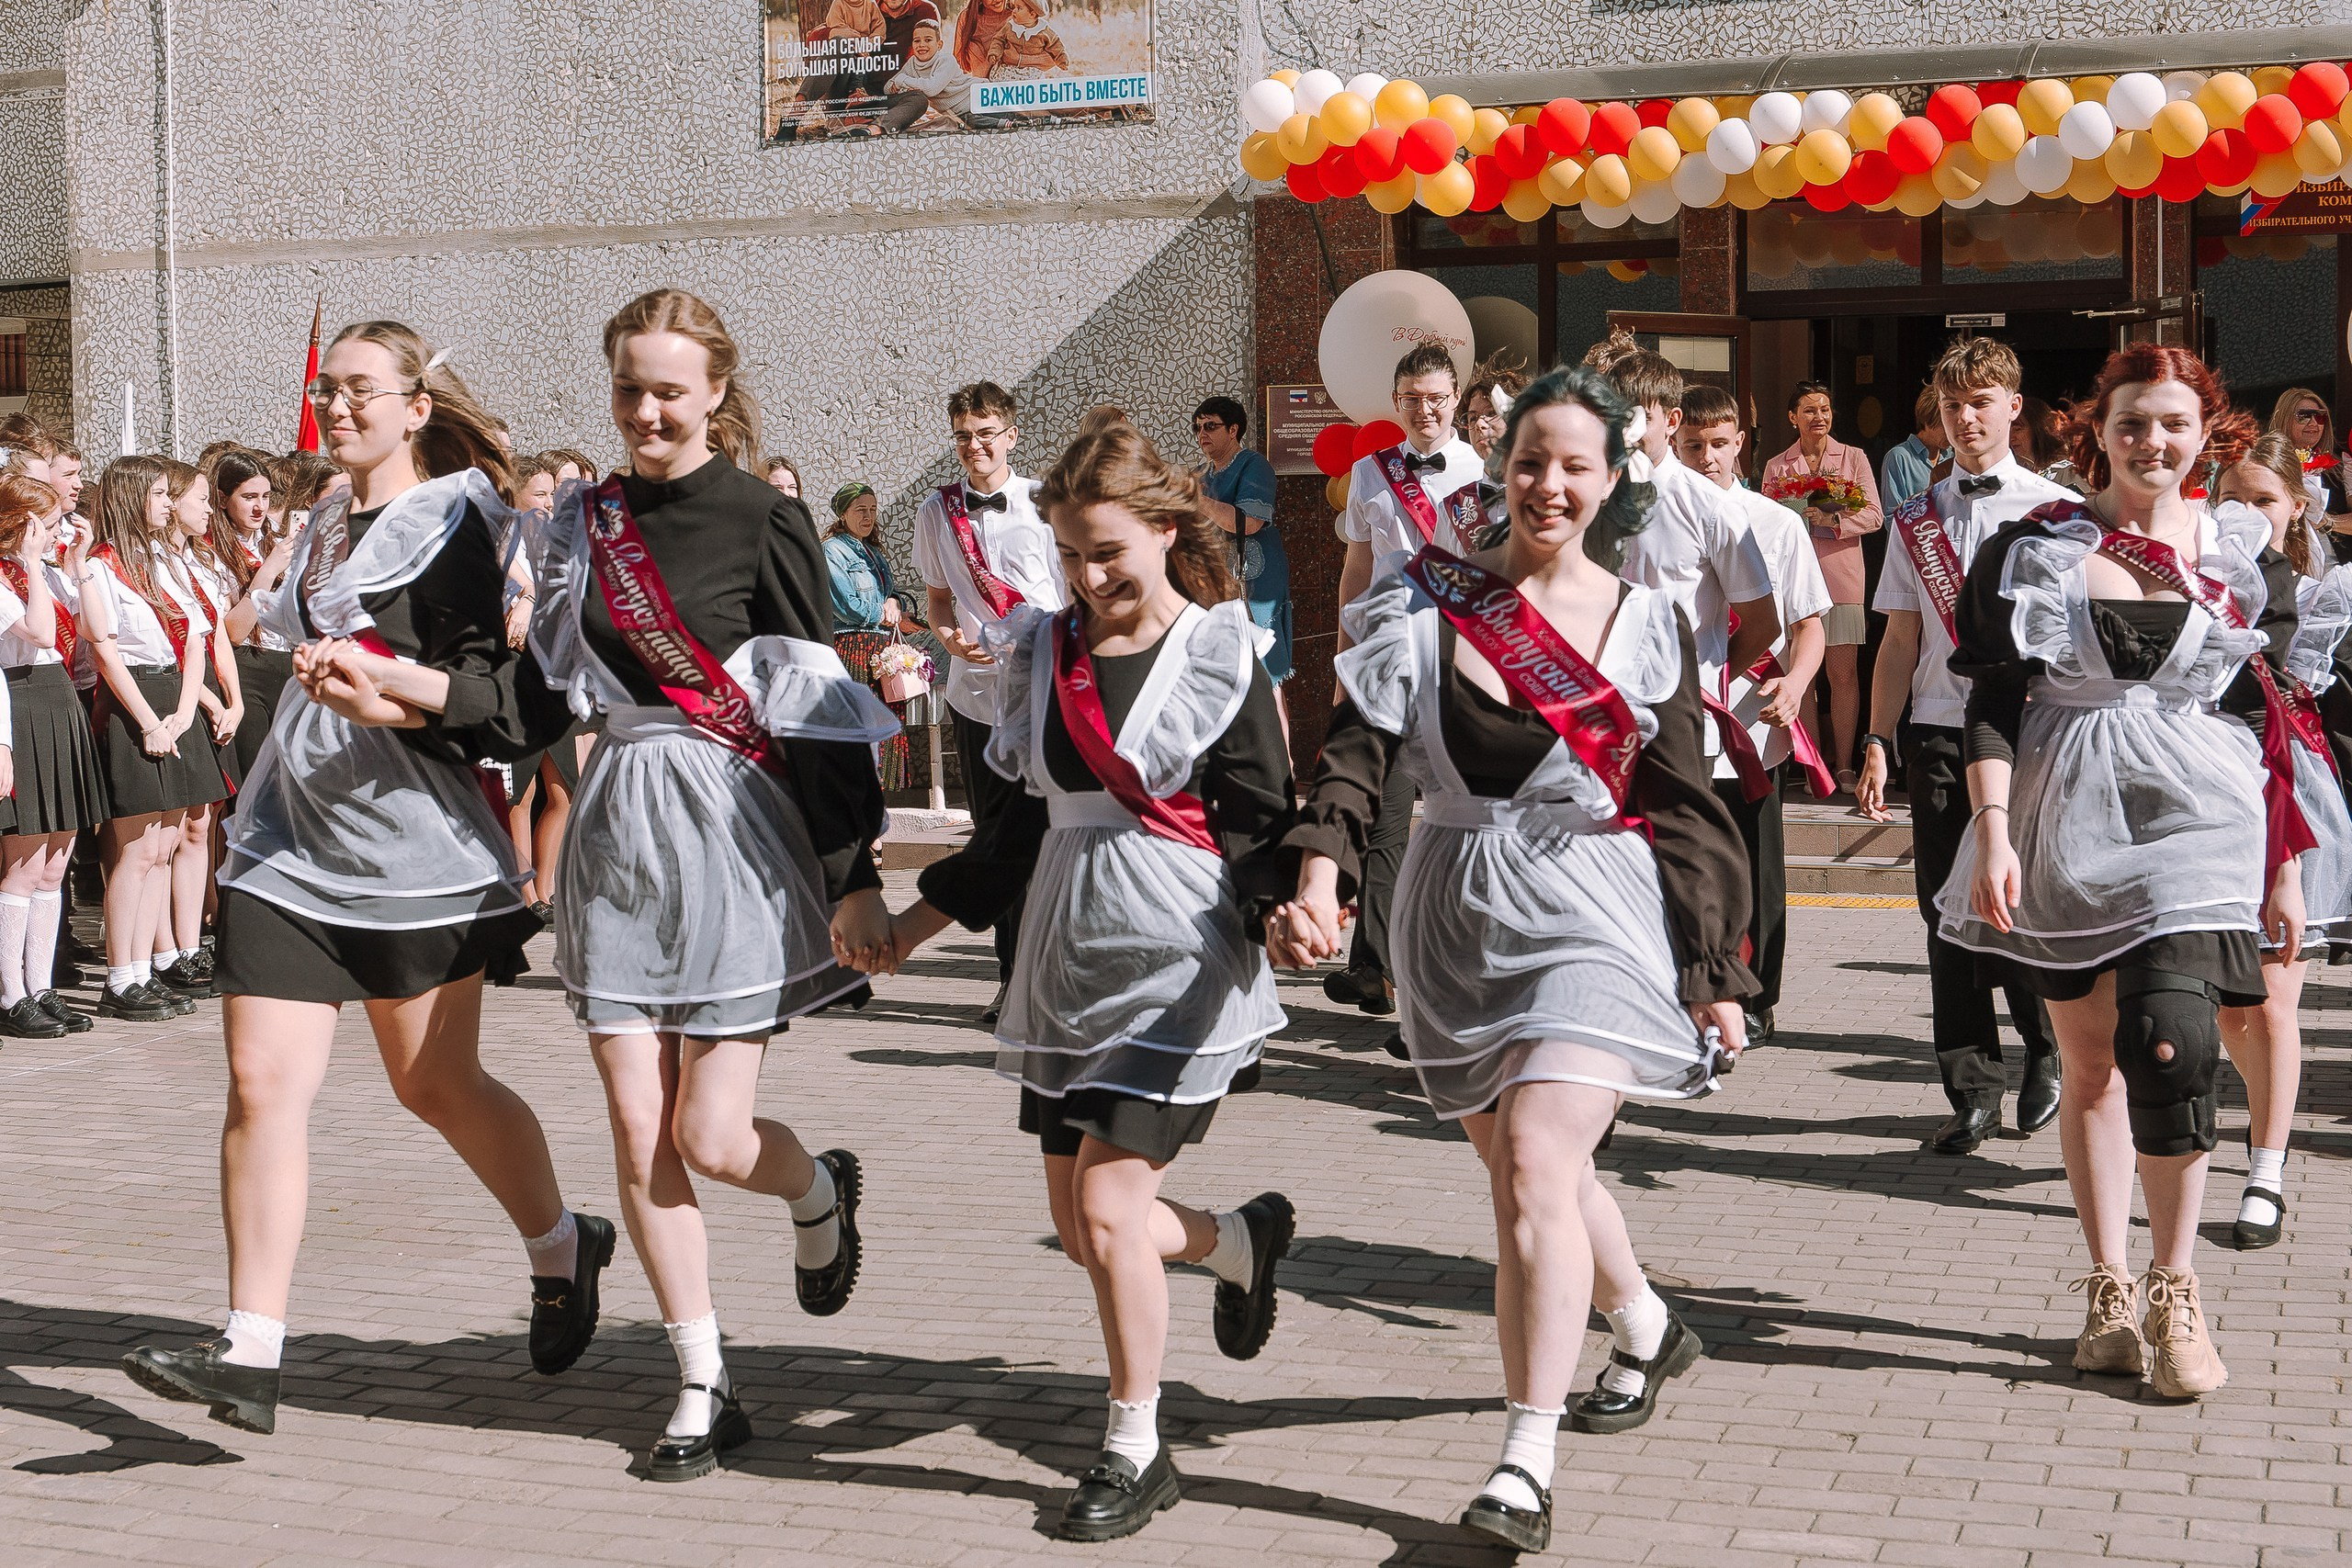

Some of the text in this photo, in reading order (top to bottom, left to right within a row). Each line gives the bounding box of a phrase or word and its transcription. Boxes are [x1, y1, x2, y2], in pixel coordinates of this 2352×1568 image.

[777, 39, 837, 59] БОЛЬШАЯ
[840, 36, 881, 55] СЕМЬЯ
[777, 54, 899, 79] БОЛЬШАЯ РАДОСТЬ!
[980, 77, 1147, 107] ВАЖНО БЫТЬ ВМЕСТЕ
[2296, 181, 2352, 194] ИЗБИР
[2318, 196, 2352, 207] КОМ
[2249, 216, 2335, 228] ИЗБИРАТЕЛЬНОГО
[1391, 326, 1407, 342] В
[1449, 335, 1467, 350] путь!
[1911, 545, 1948, 615] МАОУ СОШ №33
[604, 542, 705, 685] Выпускница
[636, 640, 660, 663] №33
[1472, 624, 1501, 650] МАОУ
[1519, 672, 1547, 696] СОШ
[1472, 589, 1617, 741] Выпускница
